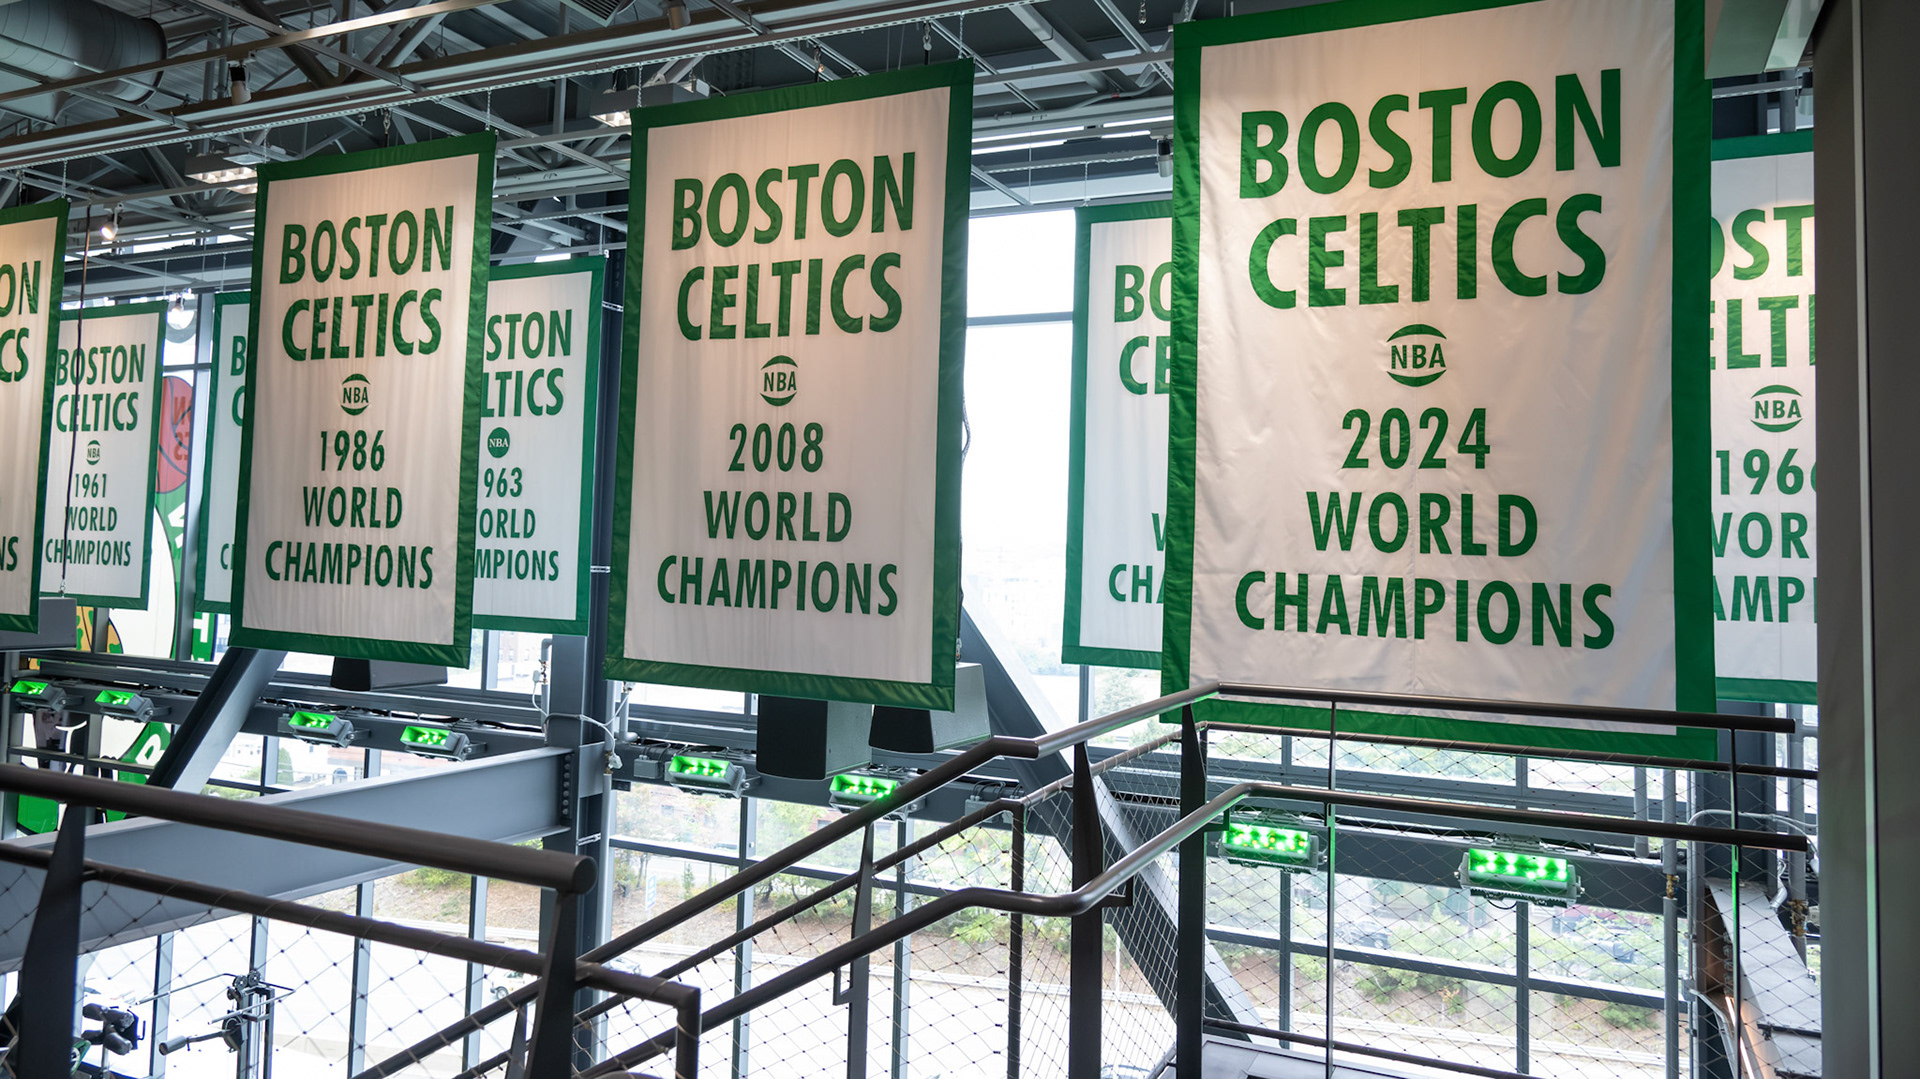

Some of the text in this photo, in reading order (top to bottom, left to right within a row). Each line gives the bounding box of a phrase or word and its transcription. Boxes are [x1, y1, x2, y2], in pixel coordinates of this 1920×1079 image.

[1240, 69, 1621, 198] BOSTON
[672, 152, 916, 250] BOSTON
[280, 205, 454, 284] BOSTON
[1249, 193, 1606, 309] CELTICS
[678, 252, 902, 346] CELTICS
[282, 288, 442, 361] CELTICS
[486, 309, 573, 361] STON
[1710, 294, 1816, 370] LT
[56, 343, 146, 386] BOSTON
[1391, 343, 1446, 369] NBA
[343, 386, 369, 404] NBA
[764, 371, 797, 392] NBA
[56, 391, 139, 433] CELTICS
[1754, 399, 1802, 419] NBA
[88, 448, 101, 458] NBA
[320, 430, 385, 471] 1986
[489, 438, 509, 448] NBA
[729, 422, 823, 472] 2008
[1343, 408, 1491, 469] 2024
[75, 473, 107, 498] 1961
[484, 467, 523, 498] 963
[1716, 448, 1817, 496] 196
[66, 506, 118, 532] WORLD
[303, 487, 403, 529] WORLD
[477, 508, 536, 539] ORLD
[704, 490, 852, 542] WORLD
[1306, 491, 1537, 556] WORLD
[45, 538, 131, 567] CHAMPIONS
[265, 541, 433, 589] CHAMPIONS
[658, 554, 898, 615] CHAMPIONS
[1108, 563, 1164, 604] CH
[1713, 575, 1817, 624] MP
[1236, 571, 1615, 650] CHAMPIONS
